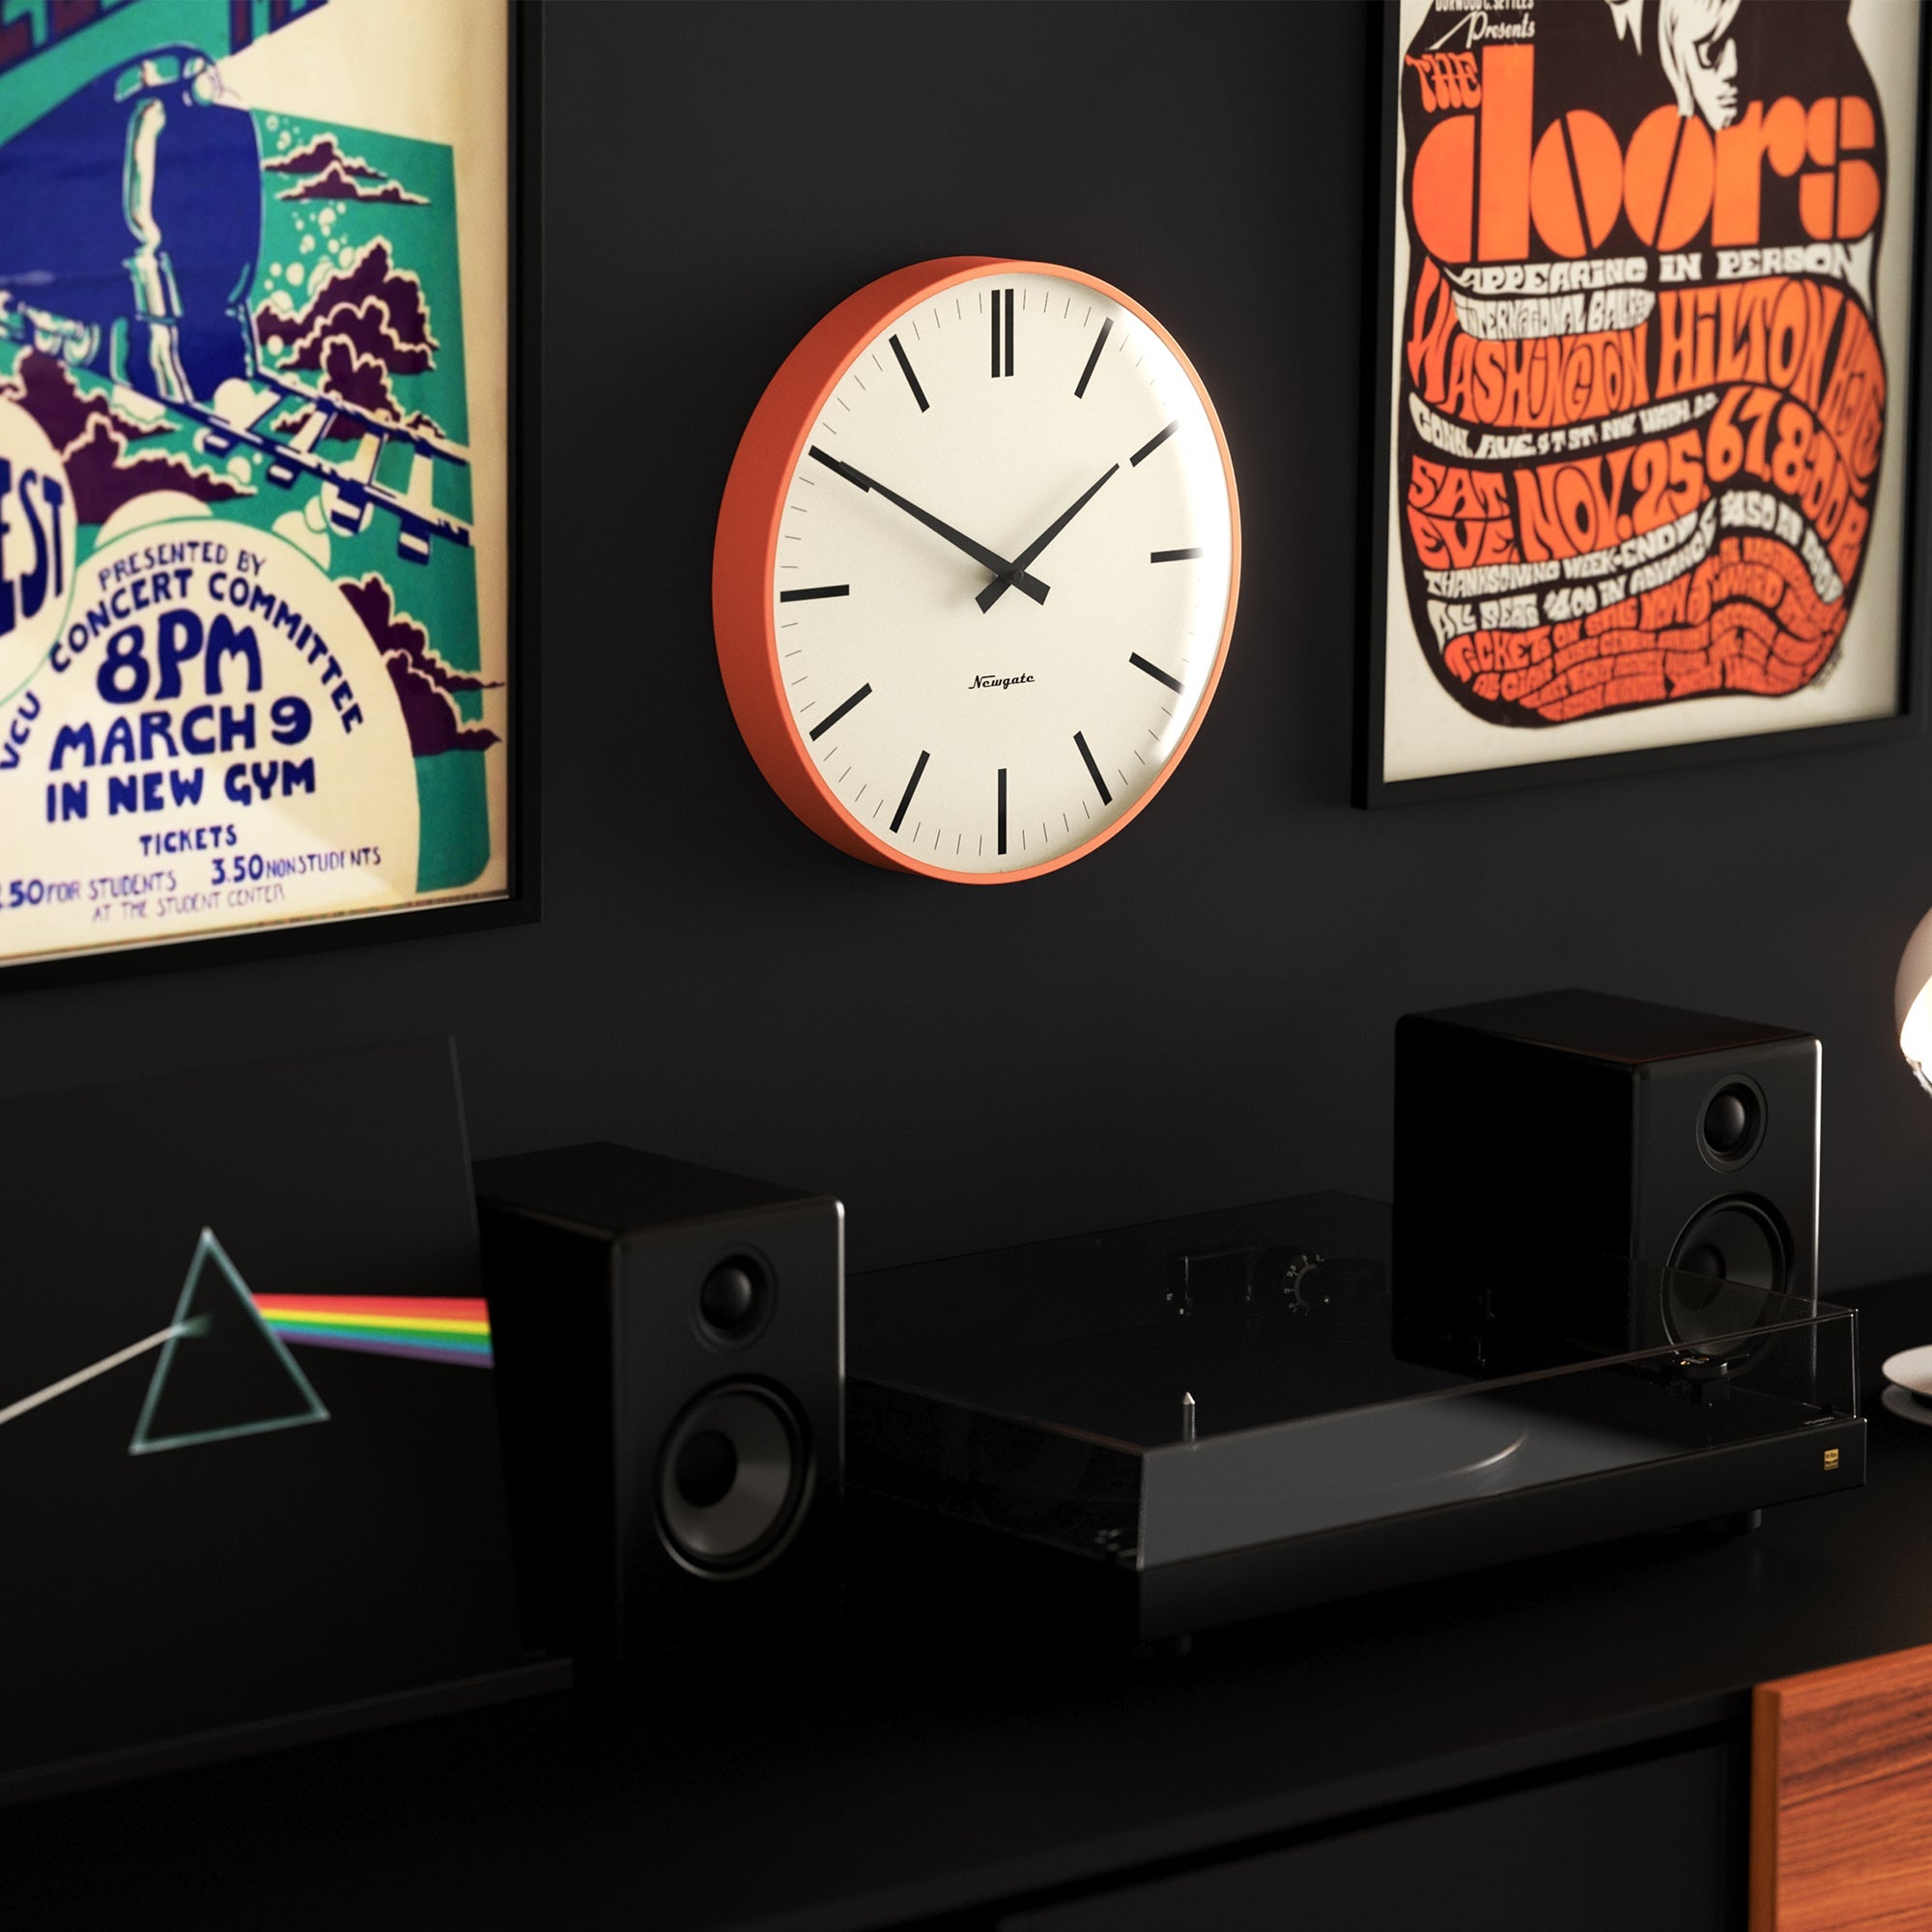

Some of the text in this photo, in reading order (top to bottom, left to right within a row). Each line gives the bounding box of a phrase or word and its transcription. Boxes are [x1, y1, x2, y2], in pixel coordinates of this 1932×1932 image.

[1426, 11, 1535, 50] Presents
[1406, 51, 1482, 113] THE
[1444, 242, 1876, 321] APPEARING IN PERSON
[1406, 255, 1650, 426] WASHINGTON
[1655, 276, 1844, 413] HILTON
[99, 541, 267, 591] PRESENTED BY
[0, 568, 364, 770] VCU CONCERT COMMITTEE
[968, 673, 1036, 690] Newgate
[49, 696, 313, 772] MARCH 9
[46, 757, 316, 823] IN NEW GYM
[139, 824, 238, 858] TICKETS
[0, 878, 45, 910] .50
[89, 869, 177, 900] STUDENTS
[93, 884, 285, 923] AT THE STUDENT CENTER
